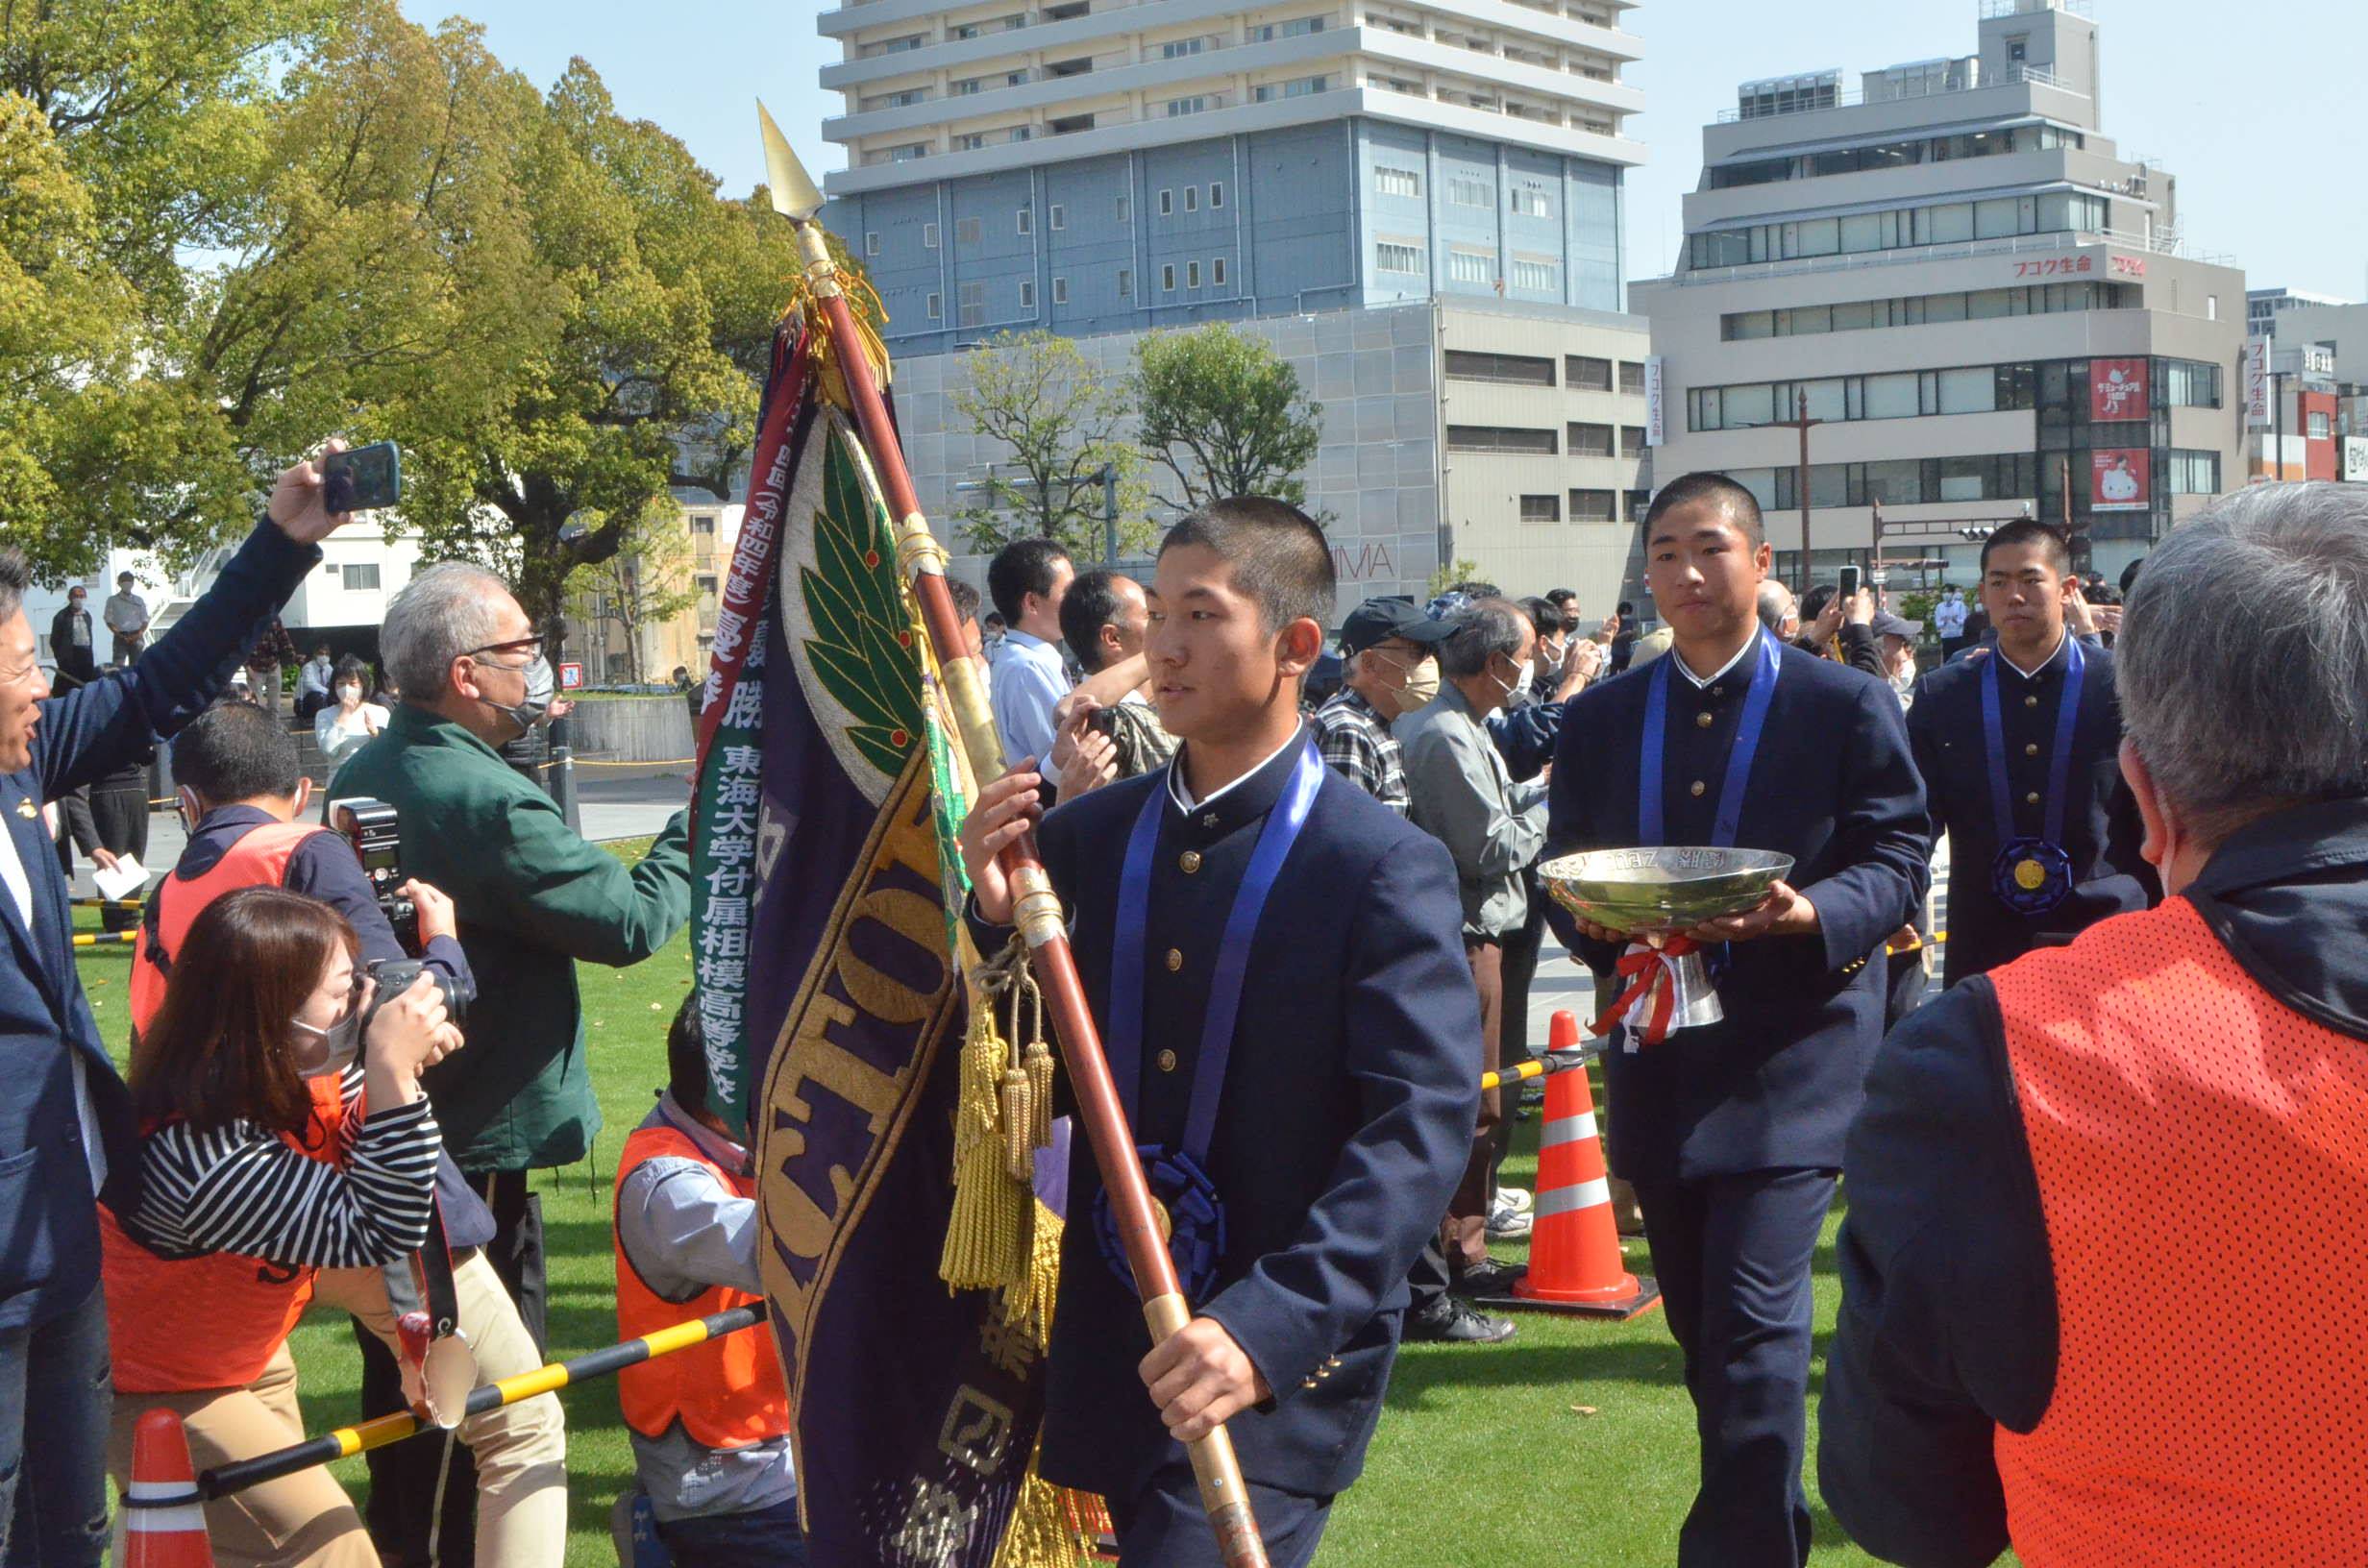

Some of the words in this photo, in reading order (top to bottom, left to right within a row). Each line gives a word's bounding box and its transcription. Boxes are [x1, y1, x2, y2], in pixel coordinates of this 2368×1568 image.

[2013, 255, 2092, 278] フコク生命
[1651, 363, 1662, 437] フコク生命
[2251, 343, 2264, 416] フコク生命
[1330, 543, 1395, 578] IMA
